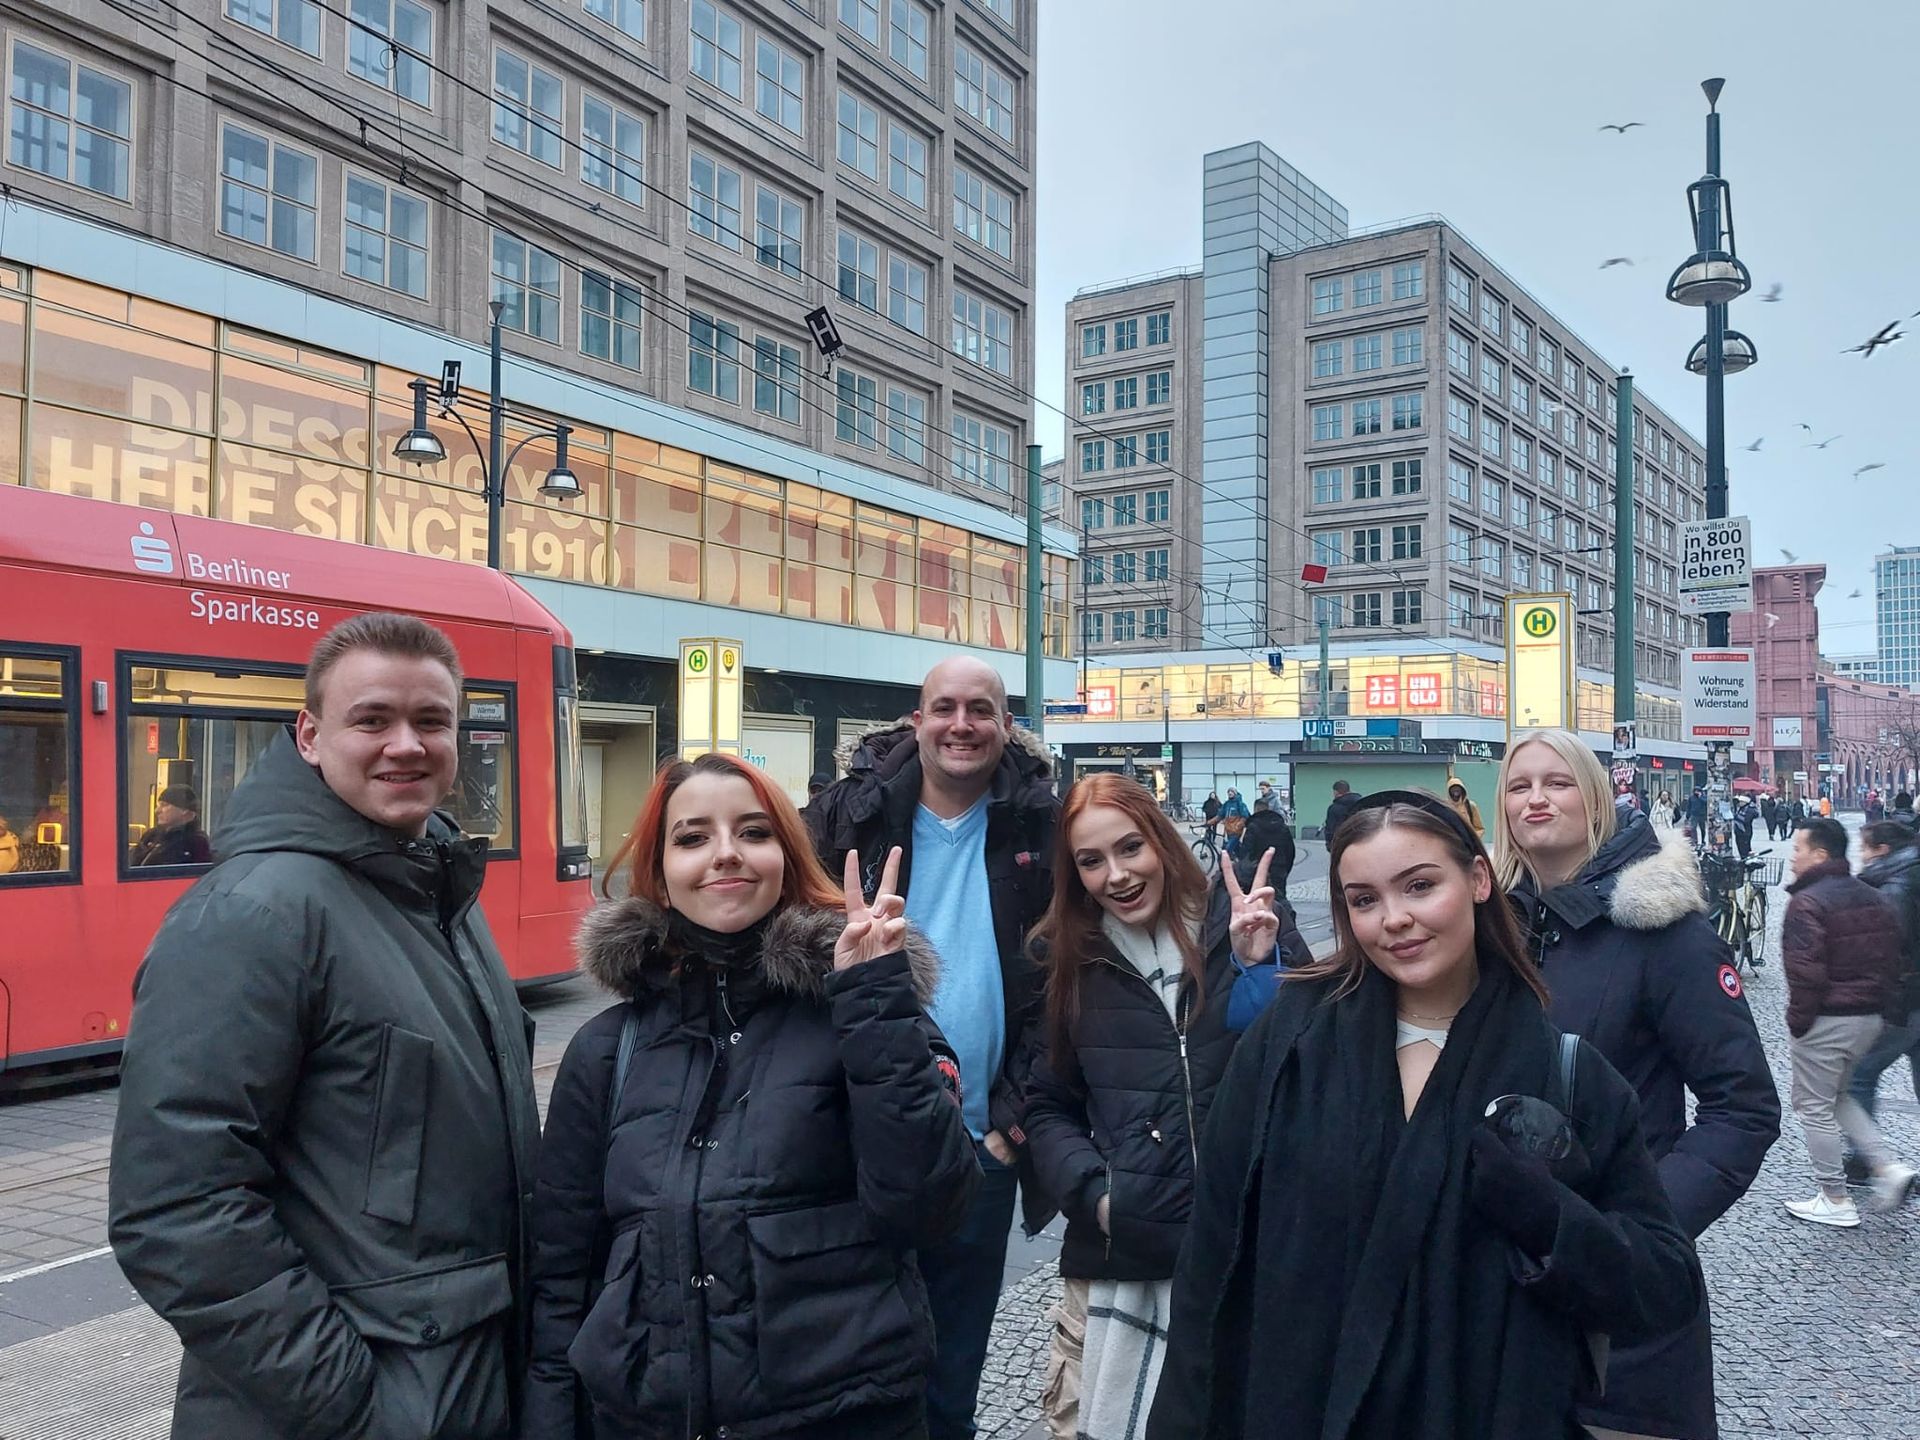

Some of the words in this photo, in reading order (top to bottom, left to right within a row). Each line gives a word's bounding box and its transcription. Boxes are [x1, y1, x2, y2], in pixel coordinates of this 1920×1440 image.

[810, 313, 838, 348] H
[443, 365, 459, 392] H
[131, 376, 488, 512] DRESSING
[509, 463, 621, 536] YOU
[1702, 521, 1725, 531] willst
[293, 484, 489, 566] SINCE
[507, 528, 622, 588] 1910
[1685, 534, 1700, 549] in
[1707, 529, 1742, 546] 800
[1682, 547, 1744, 564] Jahren
[187, 553, 291, 589] Berliner
[1682, 559, 1745, 579] leben?
[190, 591, 320, 630] Sparkasse
[1532, 614, 1547, 631] H
[694, 655, 703, 667] H
[725, 654, 733, 664] 13
[1409, 677, 1435, 689] UNI
[1698, 676, 1744, 688] Wohnung
[1409, 691, 1438, 705] QLO
[1704, 687, 1739, 696] Wärme
[1694, 698, 1748, 708] Widerstand
[1306, 721, 1317, 735] U
